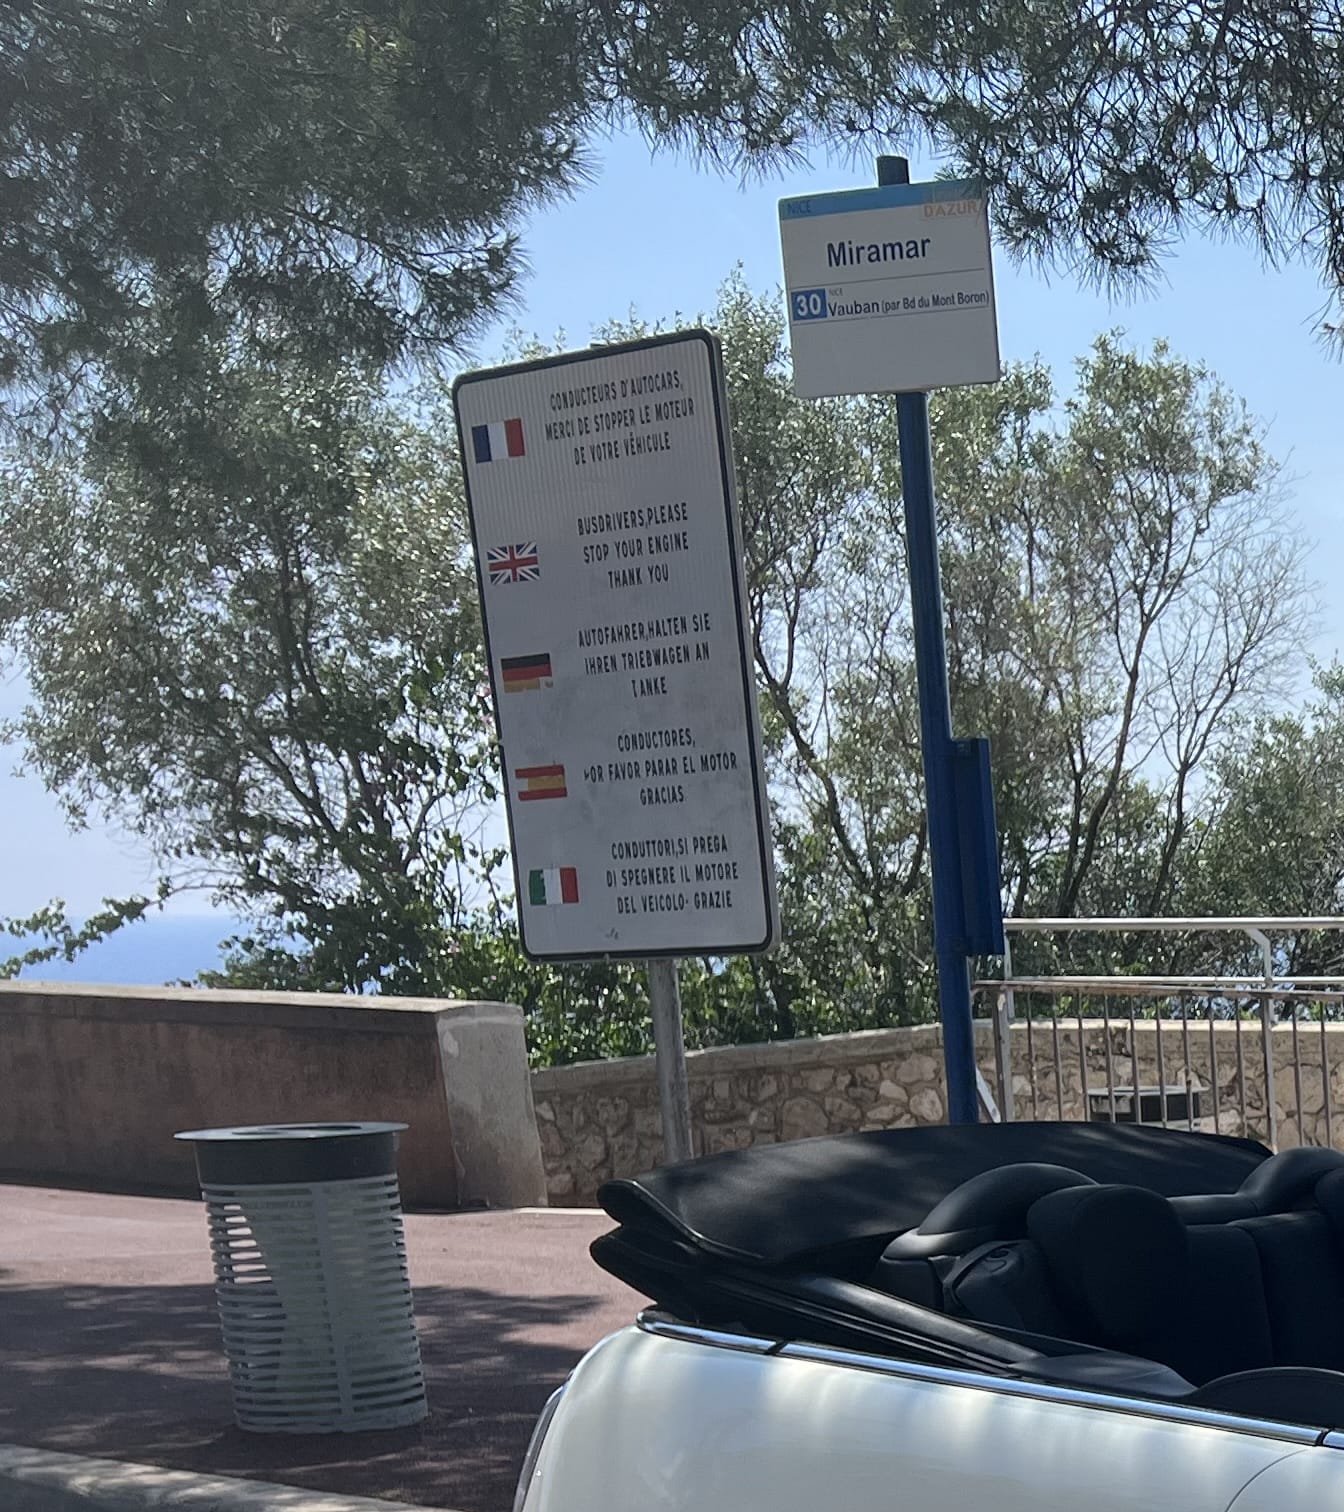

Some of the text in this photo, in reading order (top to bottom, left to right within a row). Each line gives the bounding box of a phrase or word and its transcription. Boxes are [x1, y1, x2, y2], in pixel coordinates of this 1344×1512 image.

[827, 237, 931, 268] Miramar
[796, 293, 822, 316] 30
[827, 299, 880, 317] Vauban
[881, 300, 901, 315] (par
[903, 297, 917, 310] Bd
[917, 296, 931, 309] du
[932, 292, 956, 307] Mont
[550, 382, 617, 411] CONDUCTEURS
[545, 398, 695, 441] MERCI DE STOPPER LE MOTEUR
[574, 431, 671, 465] DE VOTRE VÉHICULE
[583, 531, 689, 564] STOP YOUR ENGINE
[608, 563, 669, 589] THANK YOU
[692, 612, 711, 632] SIE
[584, 641, 710, 675] IHREN TRIEBWAGEN AN
[617, 727, 696, 752] CONDUCTORES,
[608, 761, 641, 781] FAVOR
[645, 757, 678, 777] PARAR
[682, 755, 696, 774] EL
[700, 751, 738, 772] MOTOR
[640, 785, 685, 806] GRACIAS
[693, 834, 728, 855] PREGA
[606, 862, 739, 888] DI SPEGNERE IL MOTORE
[617, 896, 637, 914] DEL
[694, 890, 733, 910] GRAZIE
